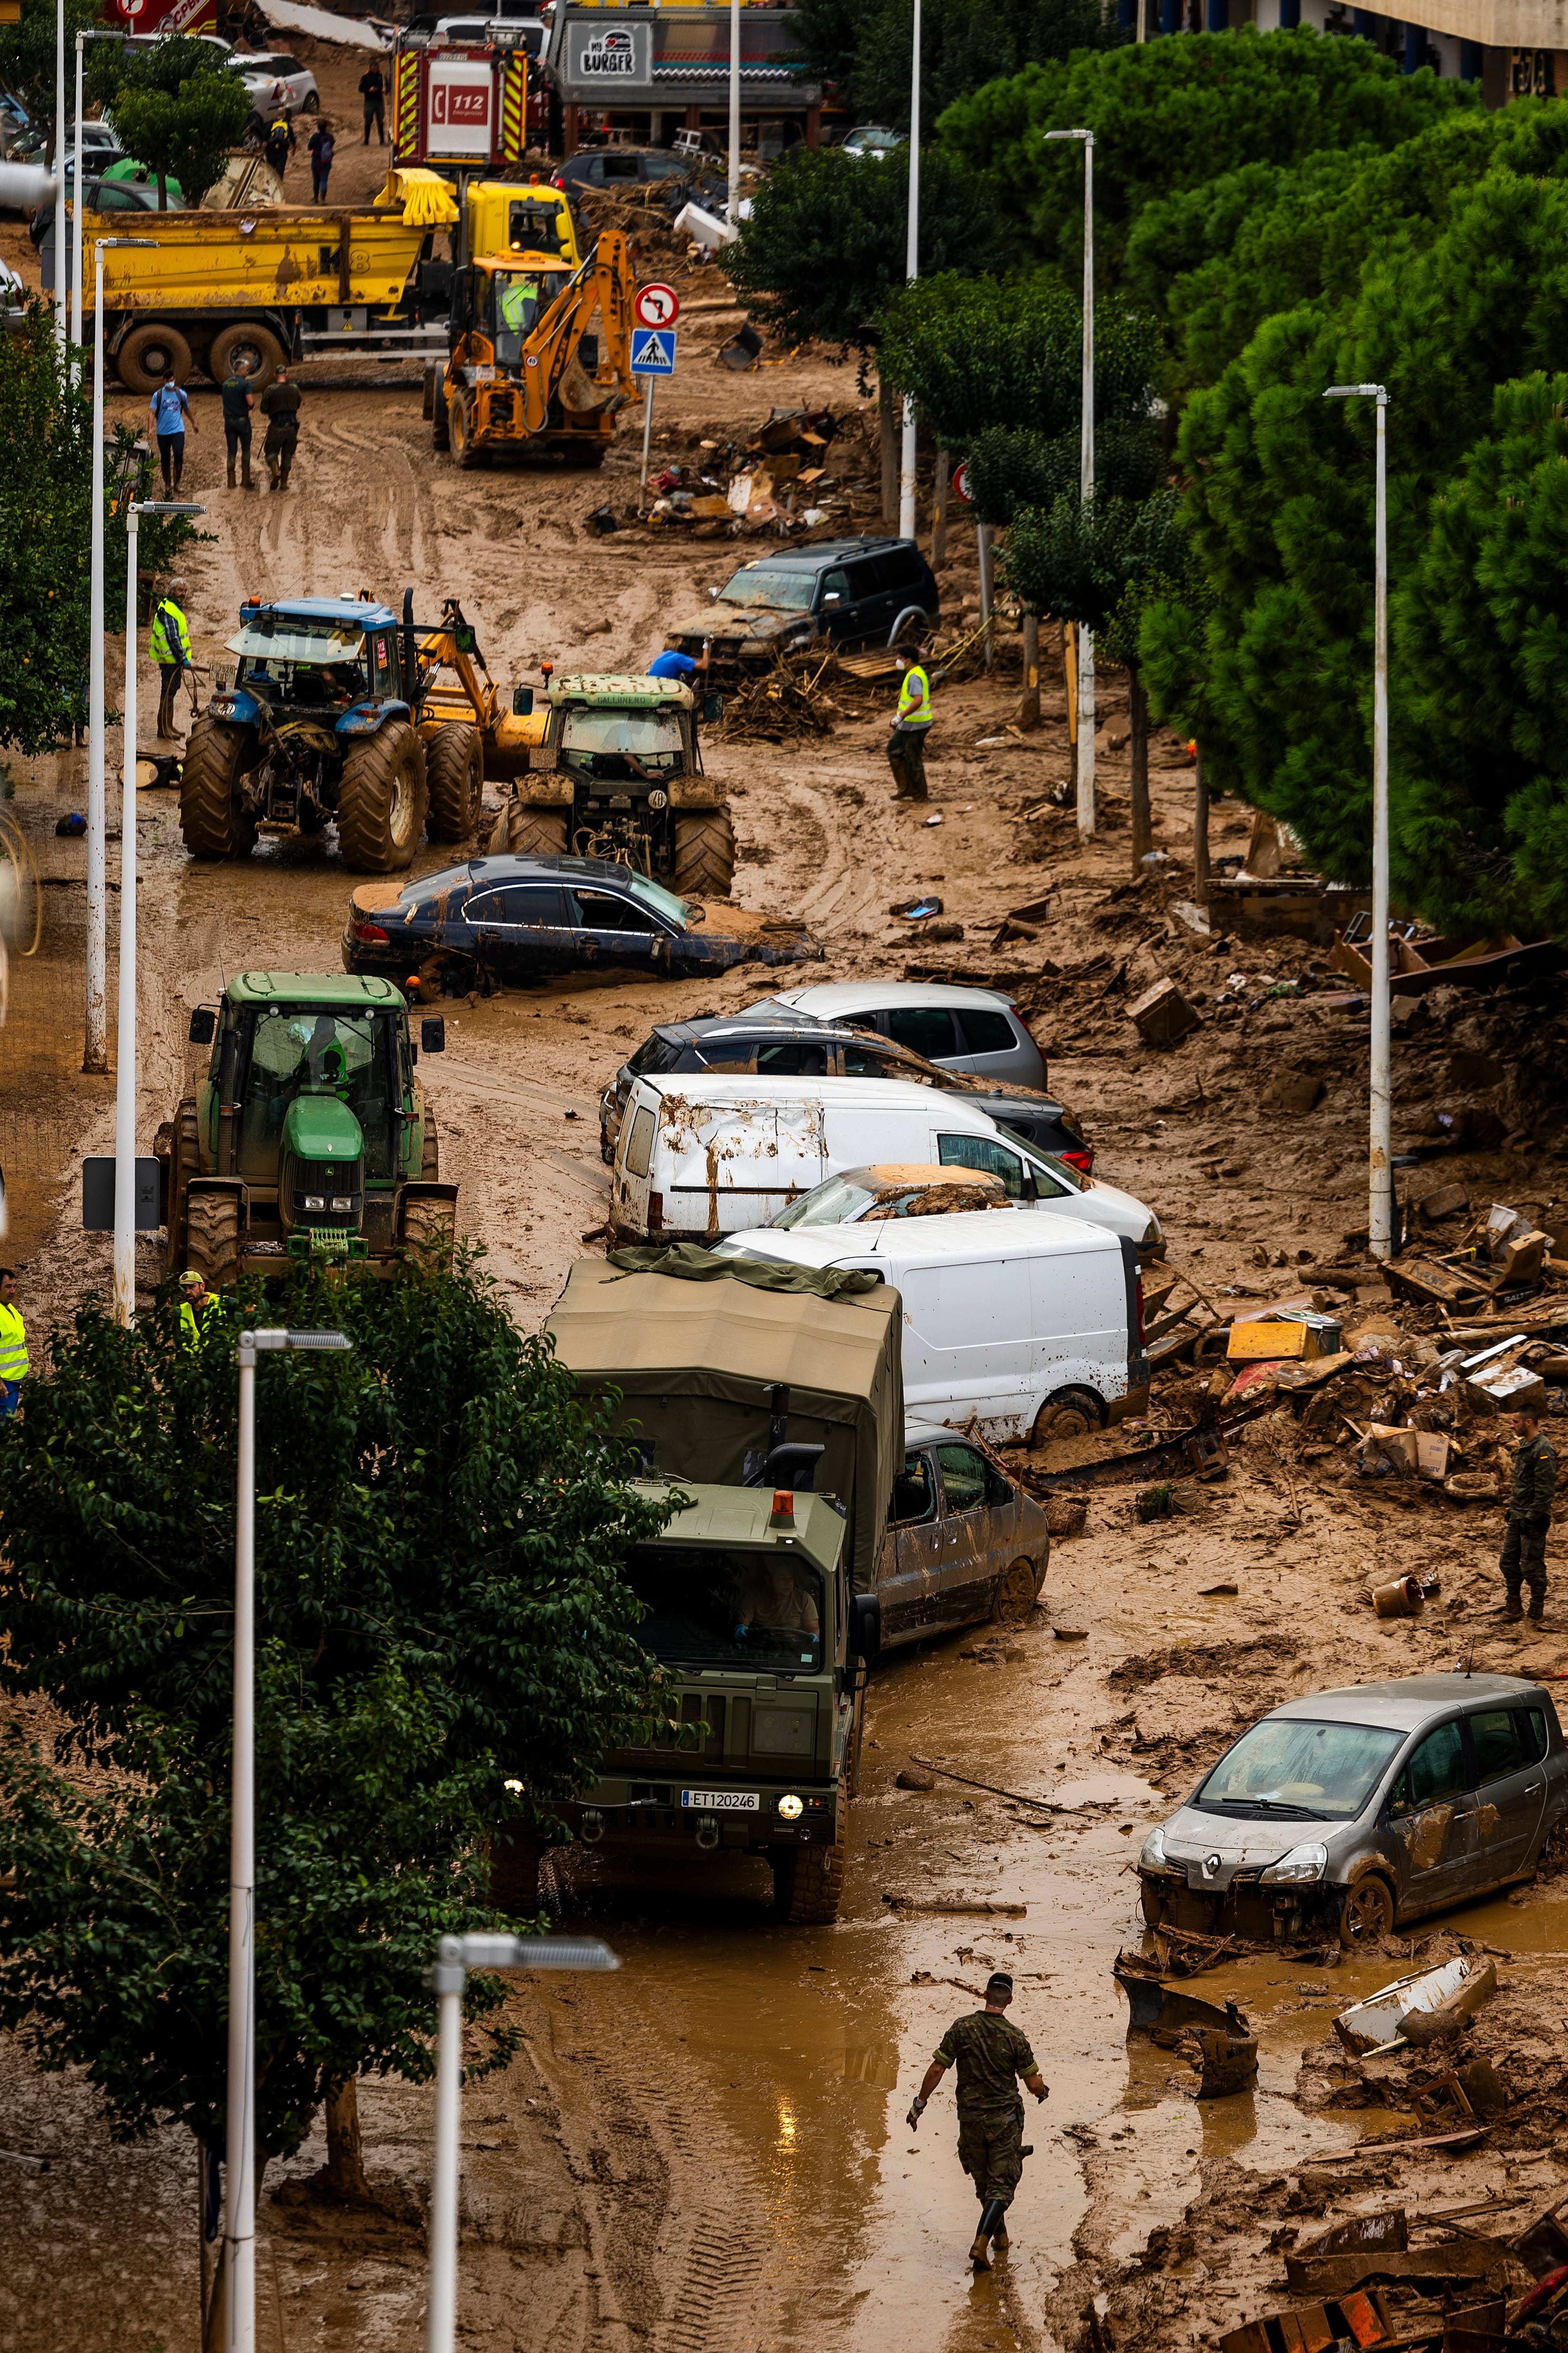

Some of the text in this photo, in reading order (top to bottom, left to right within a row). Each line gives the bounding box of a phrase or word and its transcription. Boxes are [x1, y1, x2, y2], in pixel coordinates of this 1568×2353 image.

[592, 42, 602, 52] MY
[584, 53, 633, 72] BURGER
[453, 95, 484, 110] 112
[694, 1793, 755, 1808] ET120246
